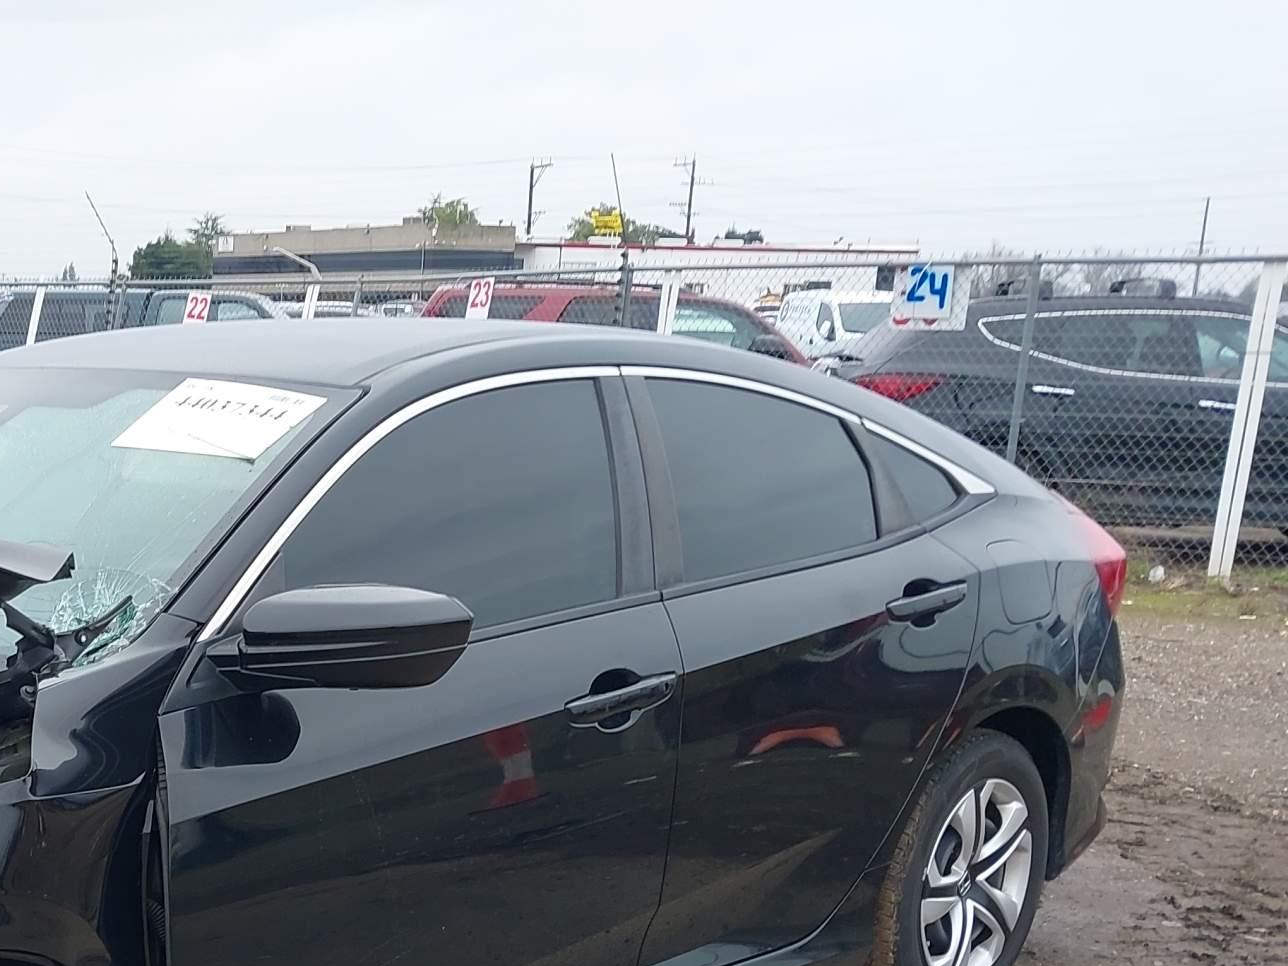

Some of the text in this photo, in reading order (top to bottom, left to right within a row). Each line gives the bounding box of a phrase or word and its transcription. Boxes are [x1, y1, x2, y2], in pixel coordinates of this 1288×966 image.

[471, 281, 491, 308] 23
[906, 265, 949, 310] 24
[187, 296, 208, 320] 22
